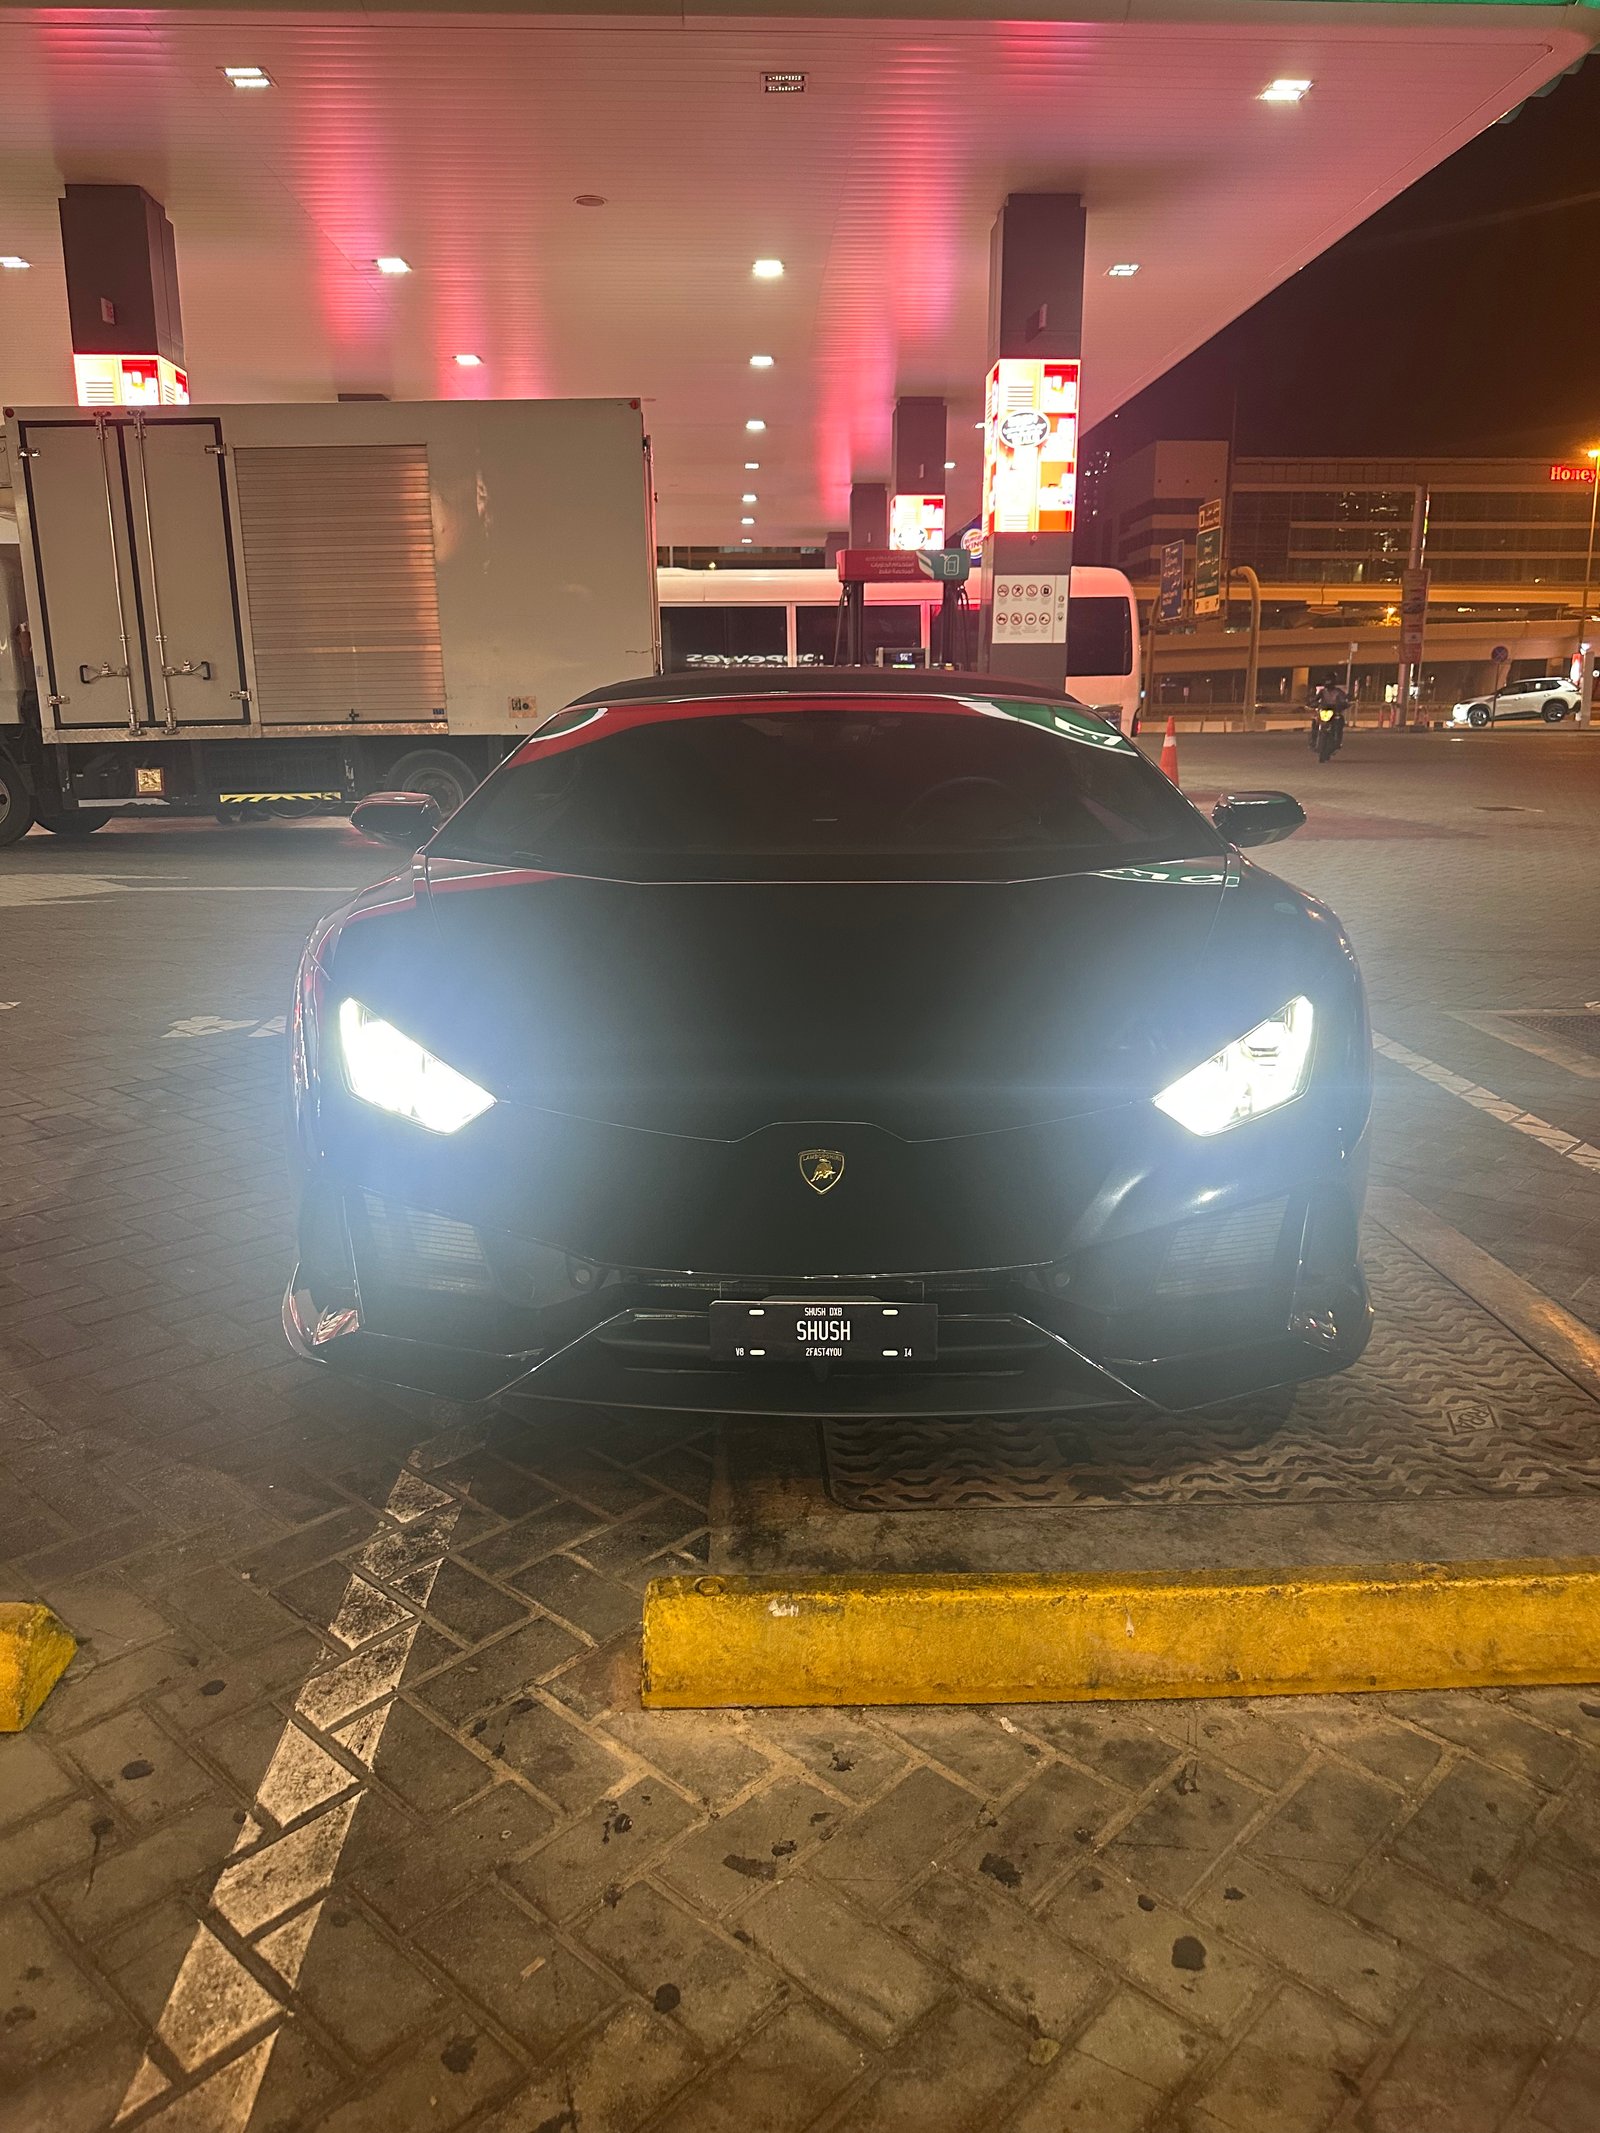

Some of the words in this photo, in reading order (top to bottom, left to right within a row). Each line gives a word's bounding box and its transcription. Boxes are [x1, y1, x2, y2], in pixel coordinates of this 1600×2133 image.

[804, 1307, 826, 1316] SHUSH
[829, 1307, 843, 1316] DXB
[796, 1320, 851, 1341] SHUSH
[805, 1347, 843, 1357] 2FAST4YOU
